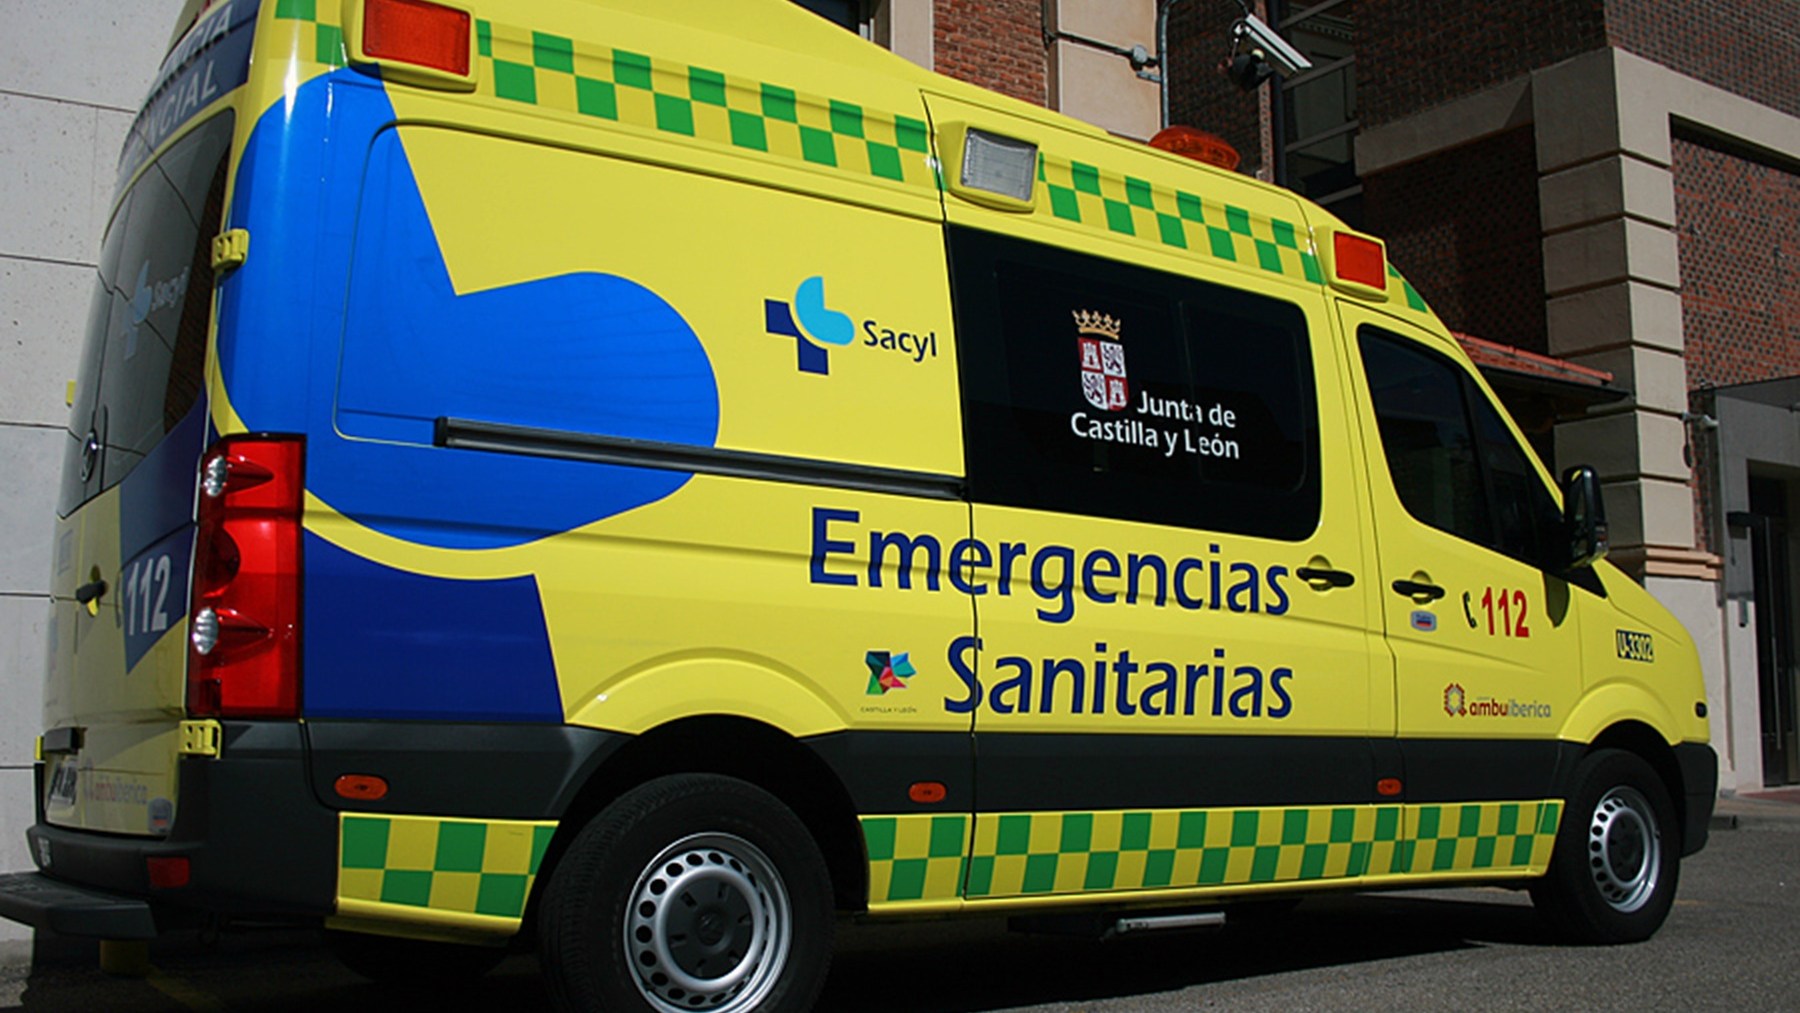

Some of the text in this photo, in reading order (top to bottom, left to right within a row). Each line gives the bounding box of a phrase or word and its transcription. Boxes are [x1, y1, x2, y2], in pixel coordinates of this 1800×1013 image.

[863, 320, 937, 363] Sacyl
[1070, 411, 1240, 460] Castilla y León
[1208, 403, 1236, 428] de
[809, 506, 1290, 624] Emergencias
[127, 554, 171, 635] 112
[1481, 586, 1530, 638] 112
[1616, 631, 1653, 661] U-3302
[943, 634, 1294, 719] Sanitarias
[1469, 698, 1551, 718] ambuiberica
